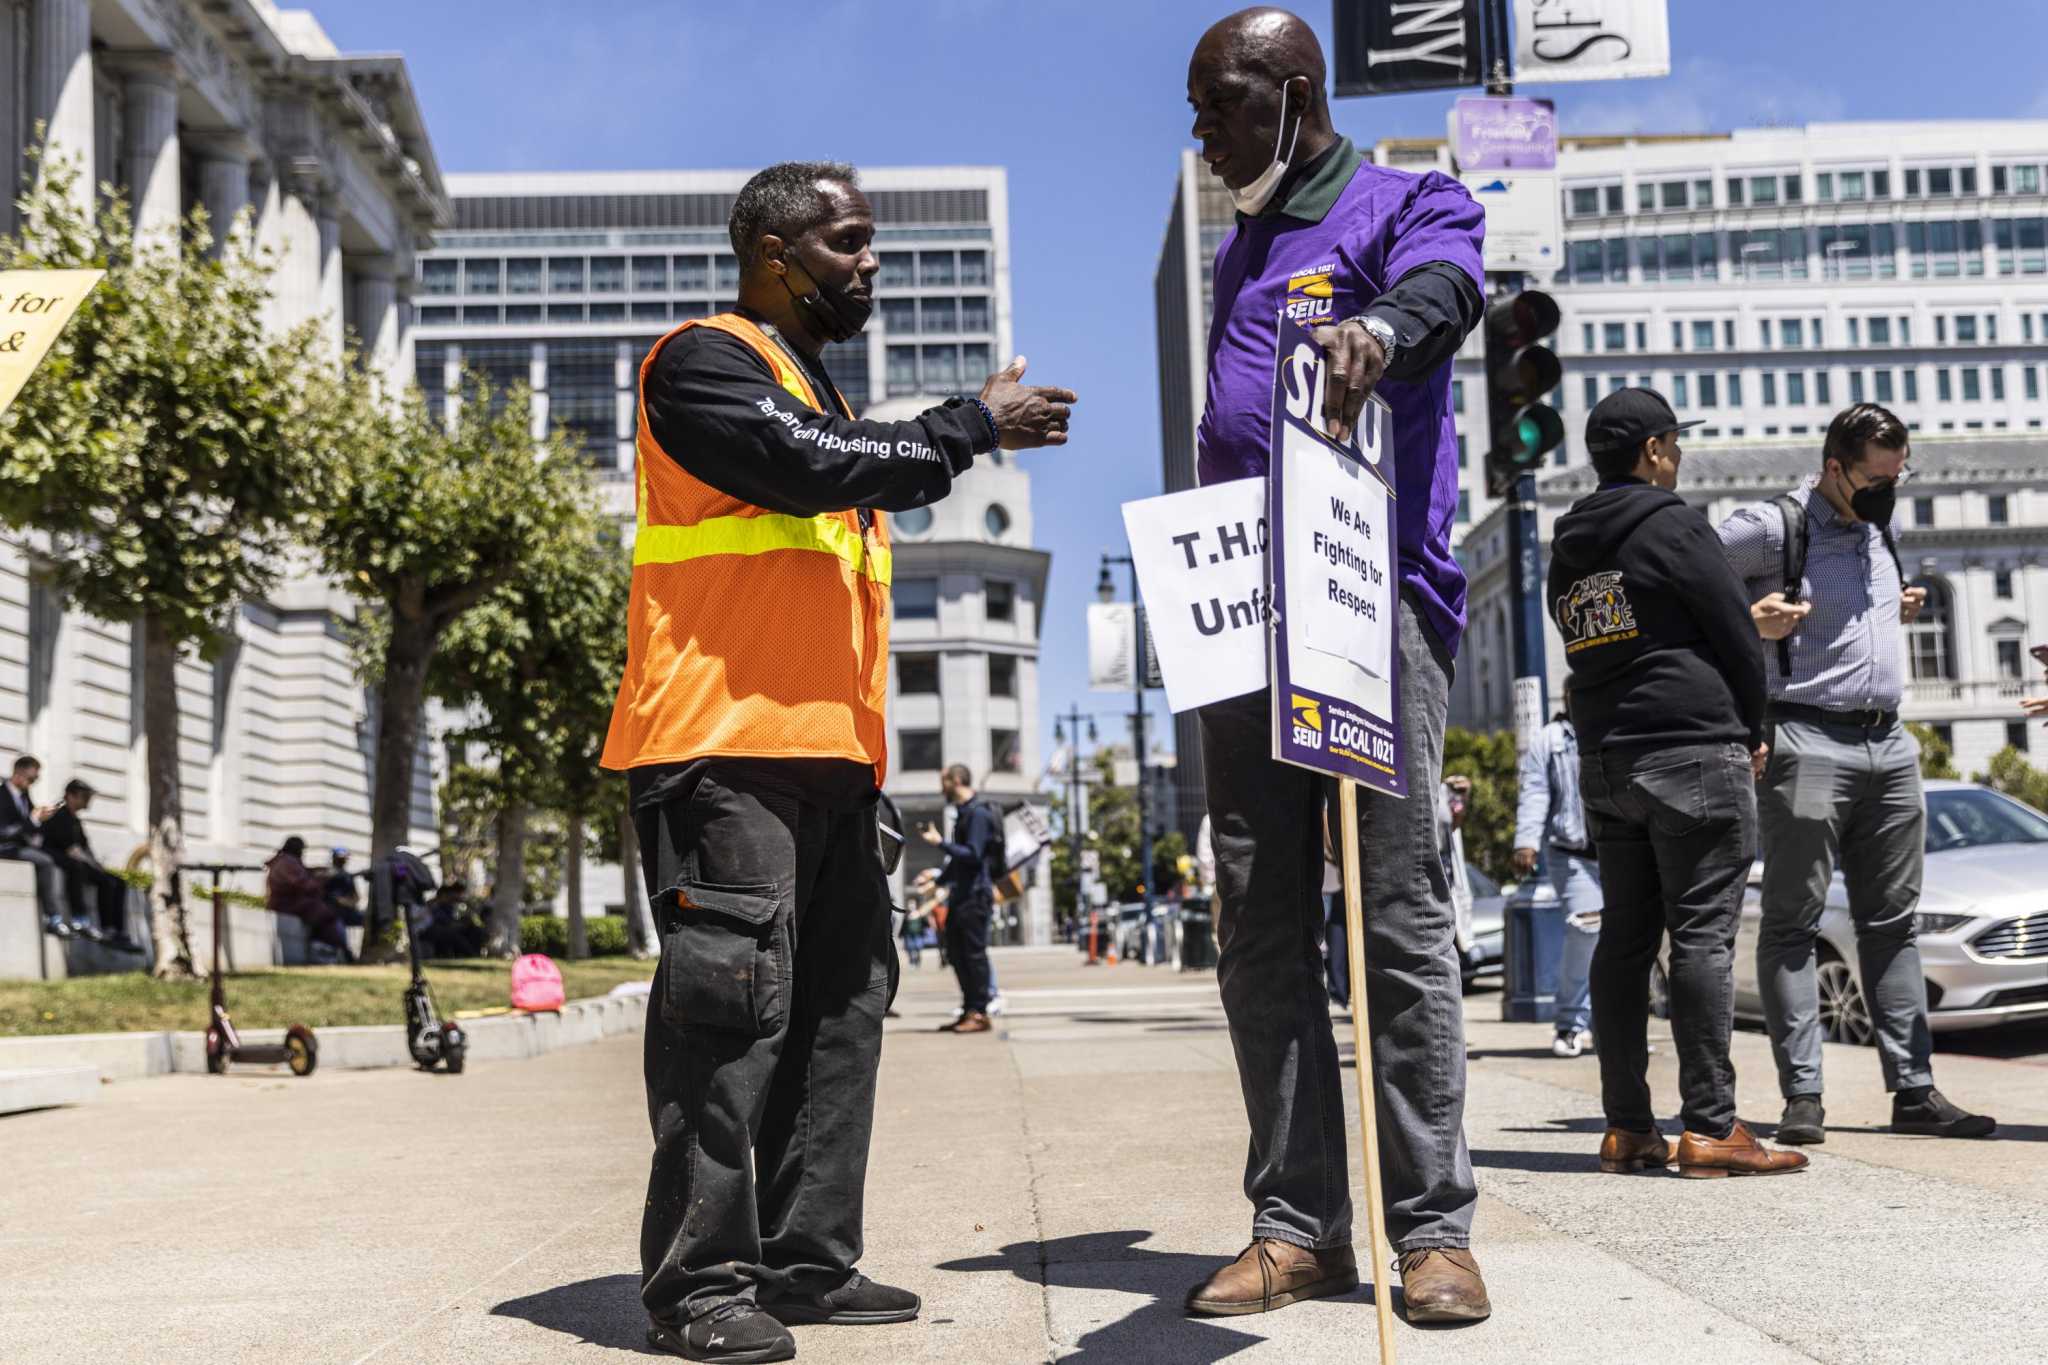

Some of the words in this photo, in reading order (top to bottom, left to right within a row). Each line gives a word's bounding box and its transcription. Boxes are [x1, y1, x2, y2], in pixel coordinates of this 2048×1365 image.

[1532, 0, 1630, 62] SF
[1318, 263, 1335, 273] 1021
[9, 292, 64, 314] for
[1286, 298, 1333, 319] SEIU
[1286, 343, 1382, 465] SU
[817, 432, 891, 460] Housing
[1331, 496, 1350, 526] We
[1354, 511, 1371, 540] Are
[1313, 531, 1367, 582] Fighting
[1370, 560, 1382, 587] for
[1328, 578, 1377, 622] Respect
[1293, 726, 1322, 750] SEIU
[1329, 719, 1371, 755] LOCAL
[1373, 736, 1394, 765] 1021
